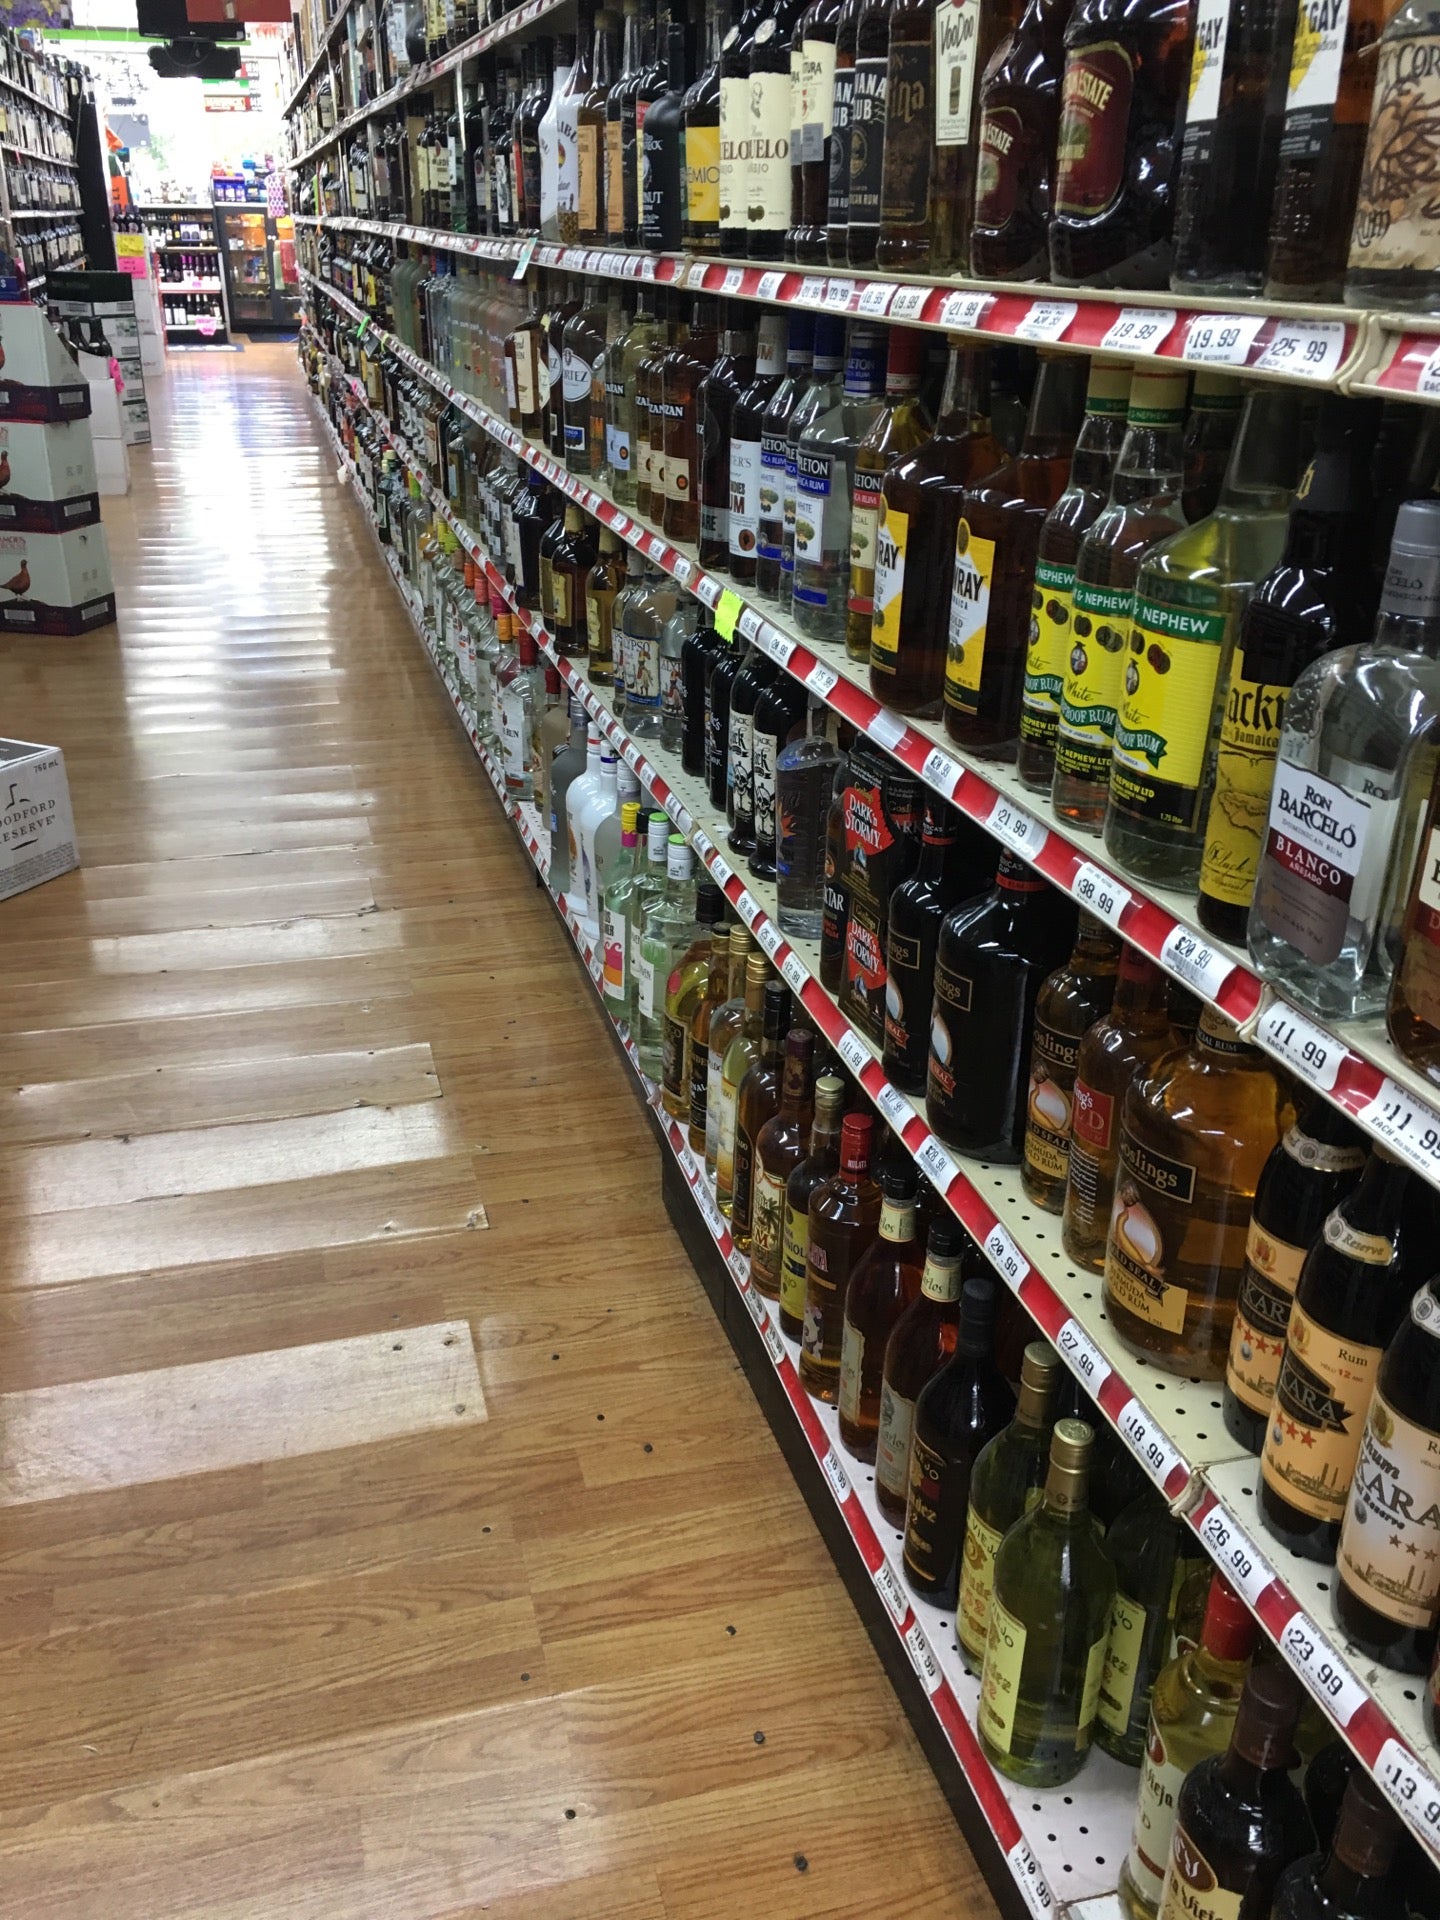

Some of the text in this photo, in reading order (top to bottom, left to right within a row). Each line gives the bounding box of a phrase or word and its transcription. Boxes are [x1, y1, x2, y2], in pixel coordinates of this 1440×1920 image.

[1112, 321, 1158, 340] $19.99
[1188, 327, 1241, 350] $19.99
[1084, 591, 1131, 609] NEPHEW
[1142, 607, 1210, 634] NEPHEW
[1089, 708, 1116, 725] RUM
[1141, 733, 1161, 752] RUM
[849, 793, 872, 819] DARK
[1304, 784, 1333, 812] RON
[844, 810, 881, 849] STORMY
[998, 807, 1028, 838] $21.99
[1277, 788, 1357, 849] BARCELÓ
[1276, 833, 1342, 886] BLANCO
[1077, 877, 1114, 915] $38.99
[851, 918, 872, 946] DARK
[847, 931, 881, 973] STORMY
[1269, 1019, 1328, 1070] $11.99
[1370, 1115, 1395, 1143] EACH
[990, 1236, 1019, 1277] $20.99
[1341, 1234, 1384, 1257] Reserve
[1128, 1260, 1157, 1289] SEAL
[1127, 1294, 1151, 1315] RUM
[1061, 1330, 1095, 1377] $27.99
[1338, 1347, 1368, 1367] Rum
[1126, 1415, 1165, 1469] $18.99
[1207, 1516, 1252, 1579] $26.99
[1287, 1627, 1344, 1696] $23.99
